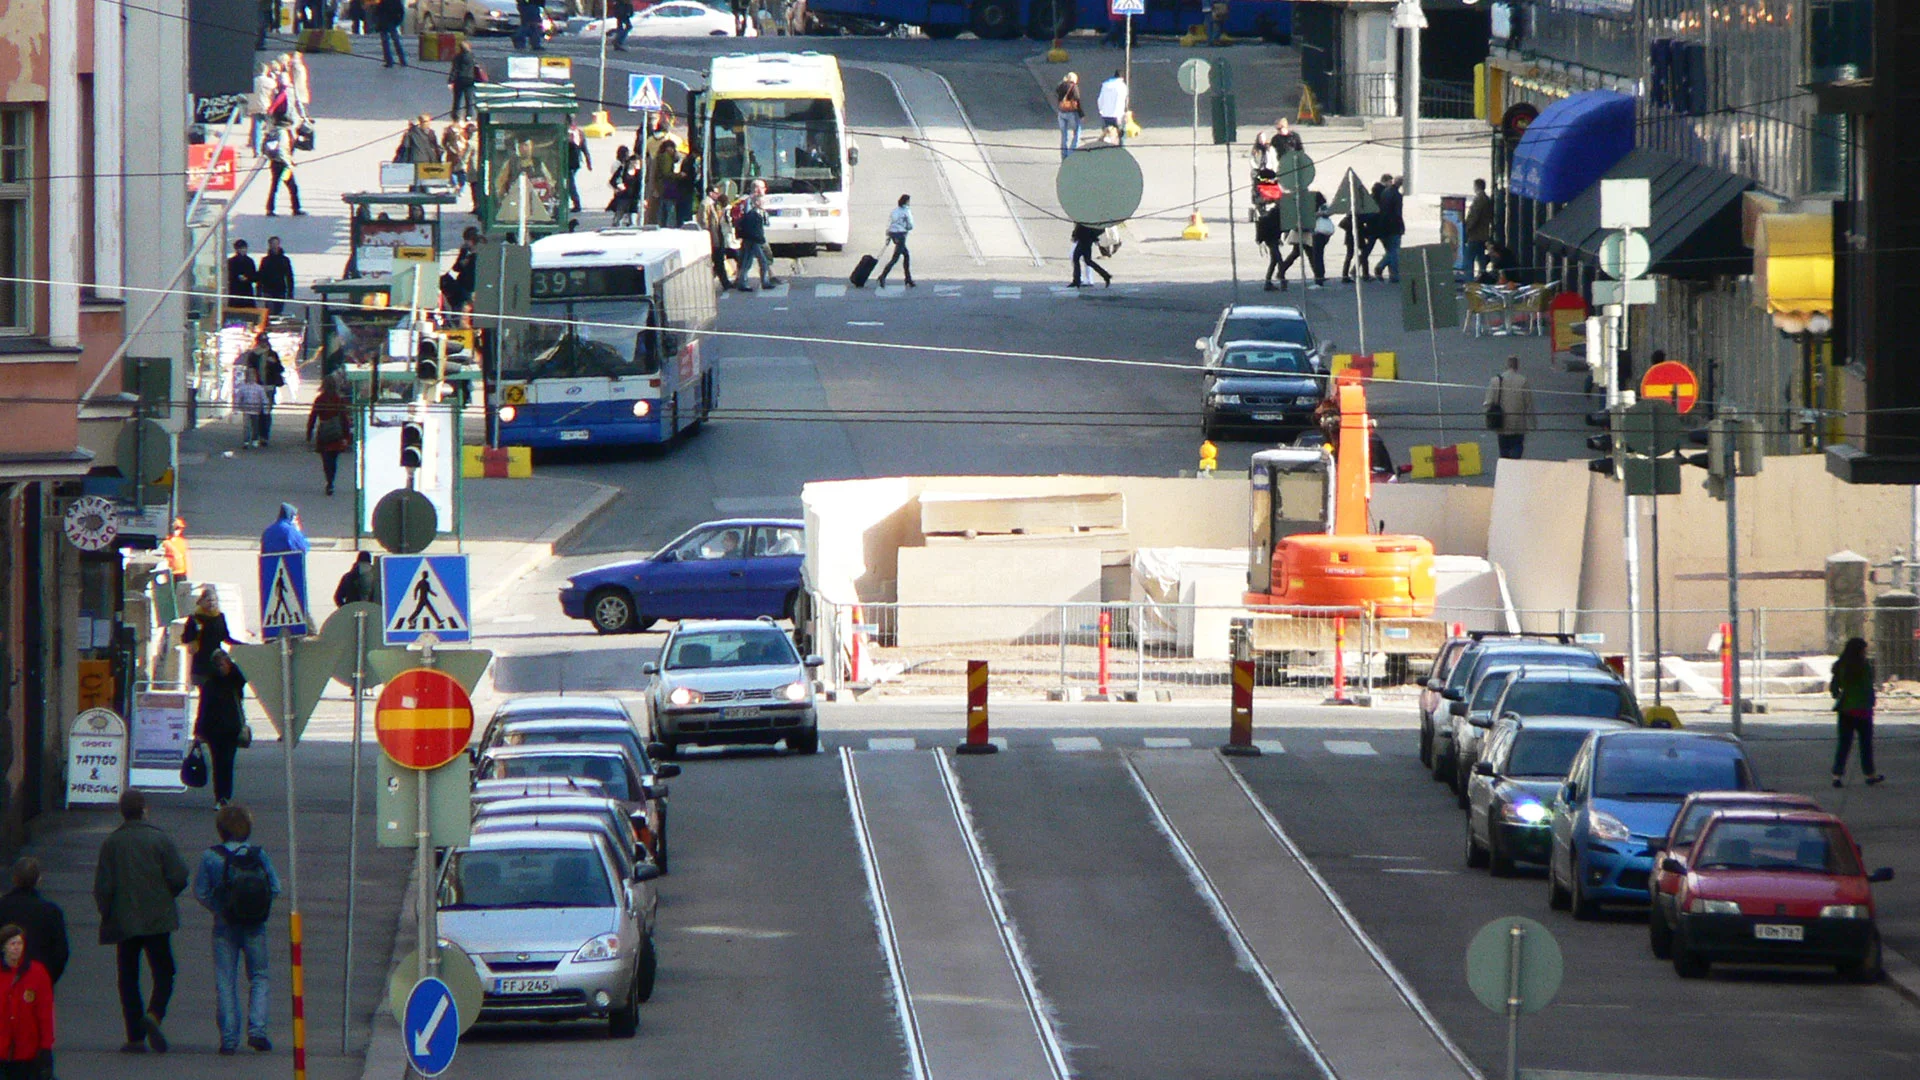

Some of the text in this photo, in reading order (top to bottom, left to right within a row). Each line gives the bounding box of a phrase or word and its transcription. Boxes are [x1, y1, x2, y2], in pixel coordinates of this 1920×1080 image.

[533, 271, 567, 294] 39
[67, 523, 117, 548] TATTOO
[75, 755, 118, 766] TATTOO
[89, 767, 99, 780] &
[502, 980, 550, 992] FFJ-245
